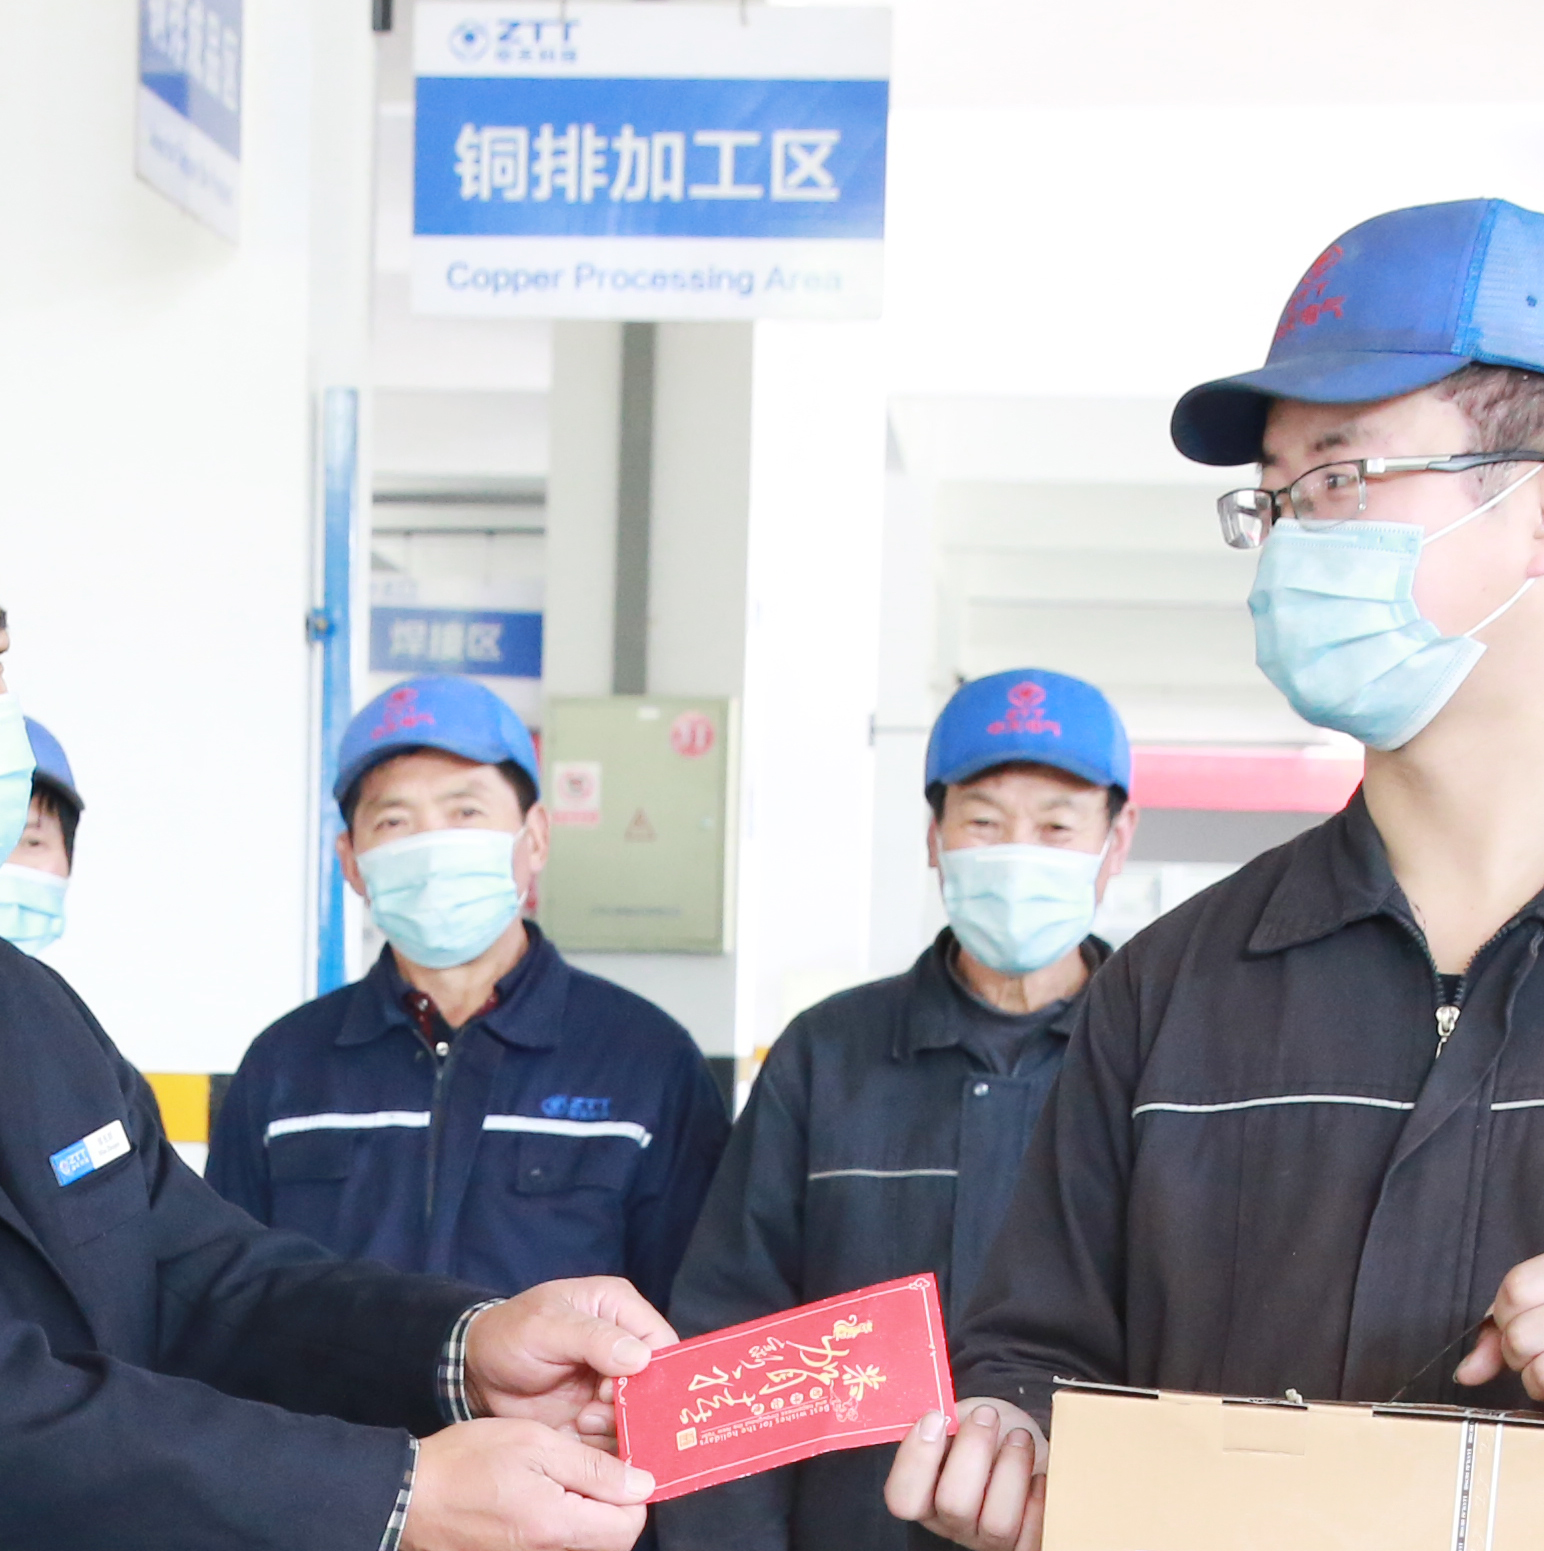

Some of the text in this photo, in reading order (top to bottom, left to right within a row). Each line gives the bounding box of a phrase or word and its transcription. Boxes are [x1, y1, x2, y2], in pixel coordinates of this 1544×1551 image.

[497, 18, 580, 43] ZTT
[454, 123, 841, 202] 铜排加工区
[447, 262, 843, 296] Copper Processing Area
